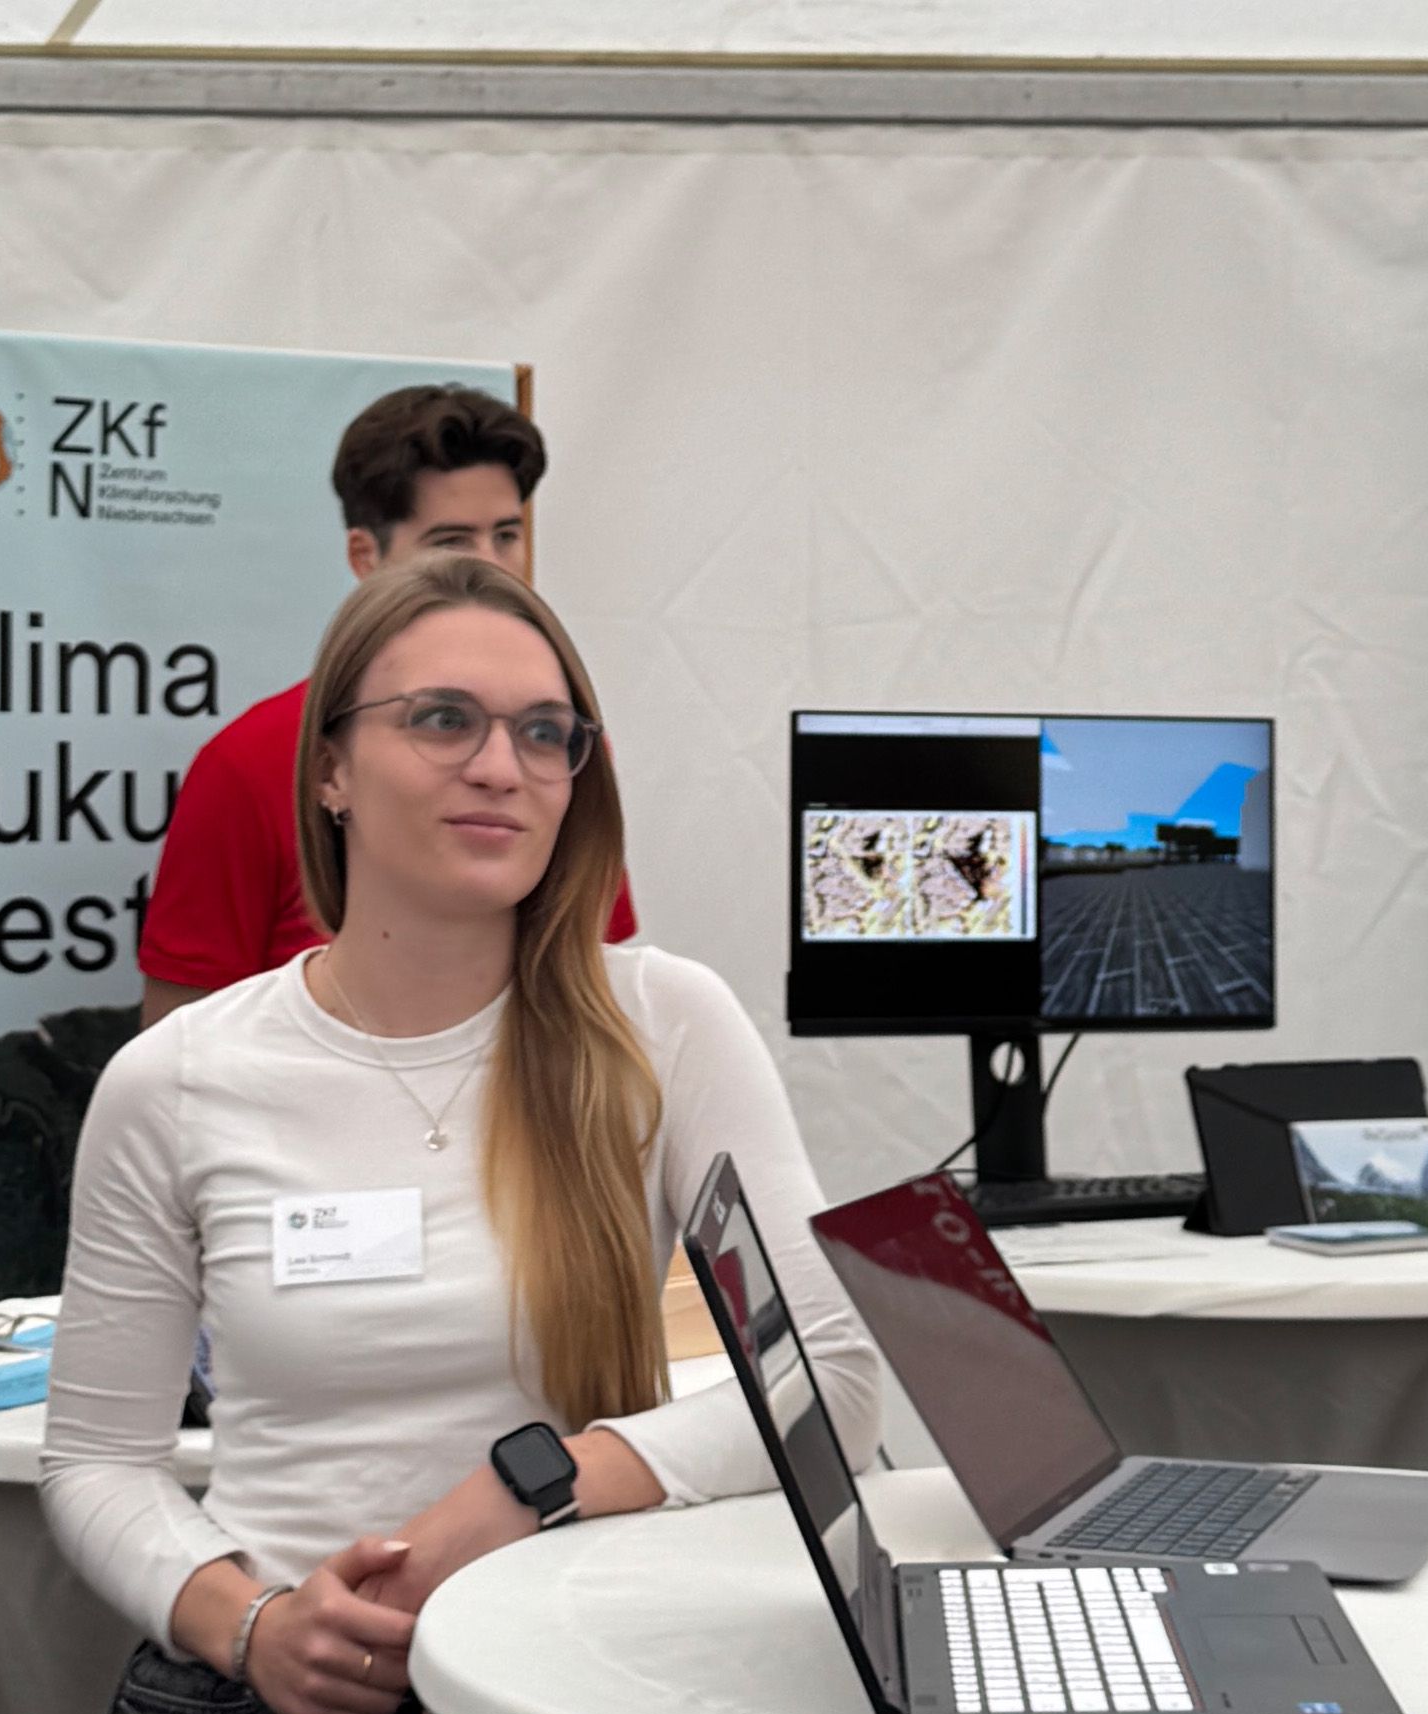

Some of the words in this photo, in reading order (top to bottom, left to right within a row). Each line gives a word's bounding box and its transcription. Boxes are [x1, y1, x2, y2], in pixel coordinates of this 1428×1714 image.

[52, 396, 167, 458] ZKf
[48, 460, 94, 518] N
[98, 463, 167, 483] Zentrum
[97, 484, 222, 509] Klimaforschung
[97, 505, 217, 526] Niedersachsen
